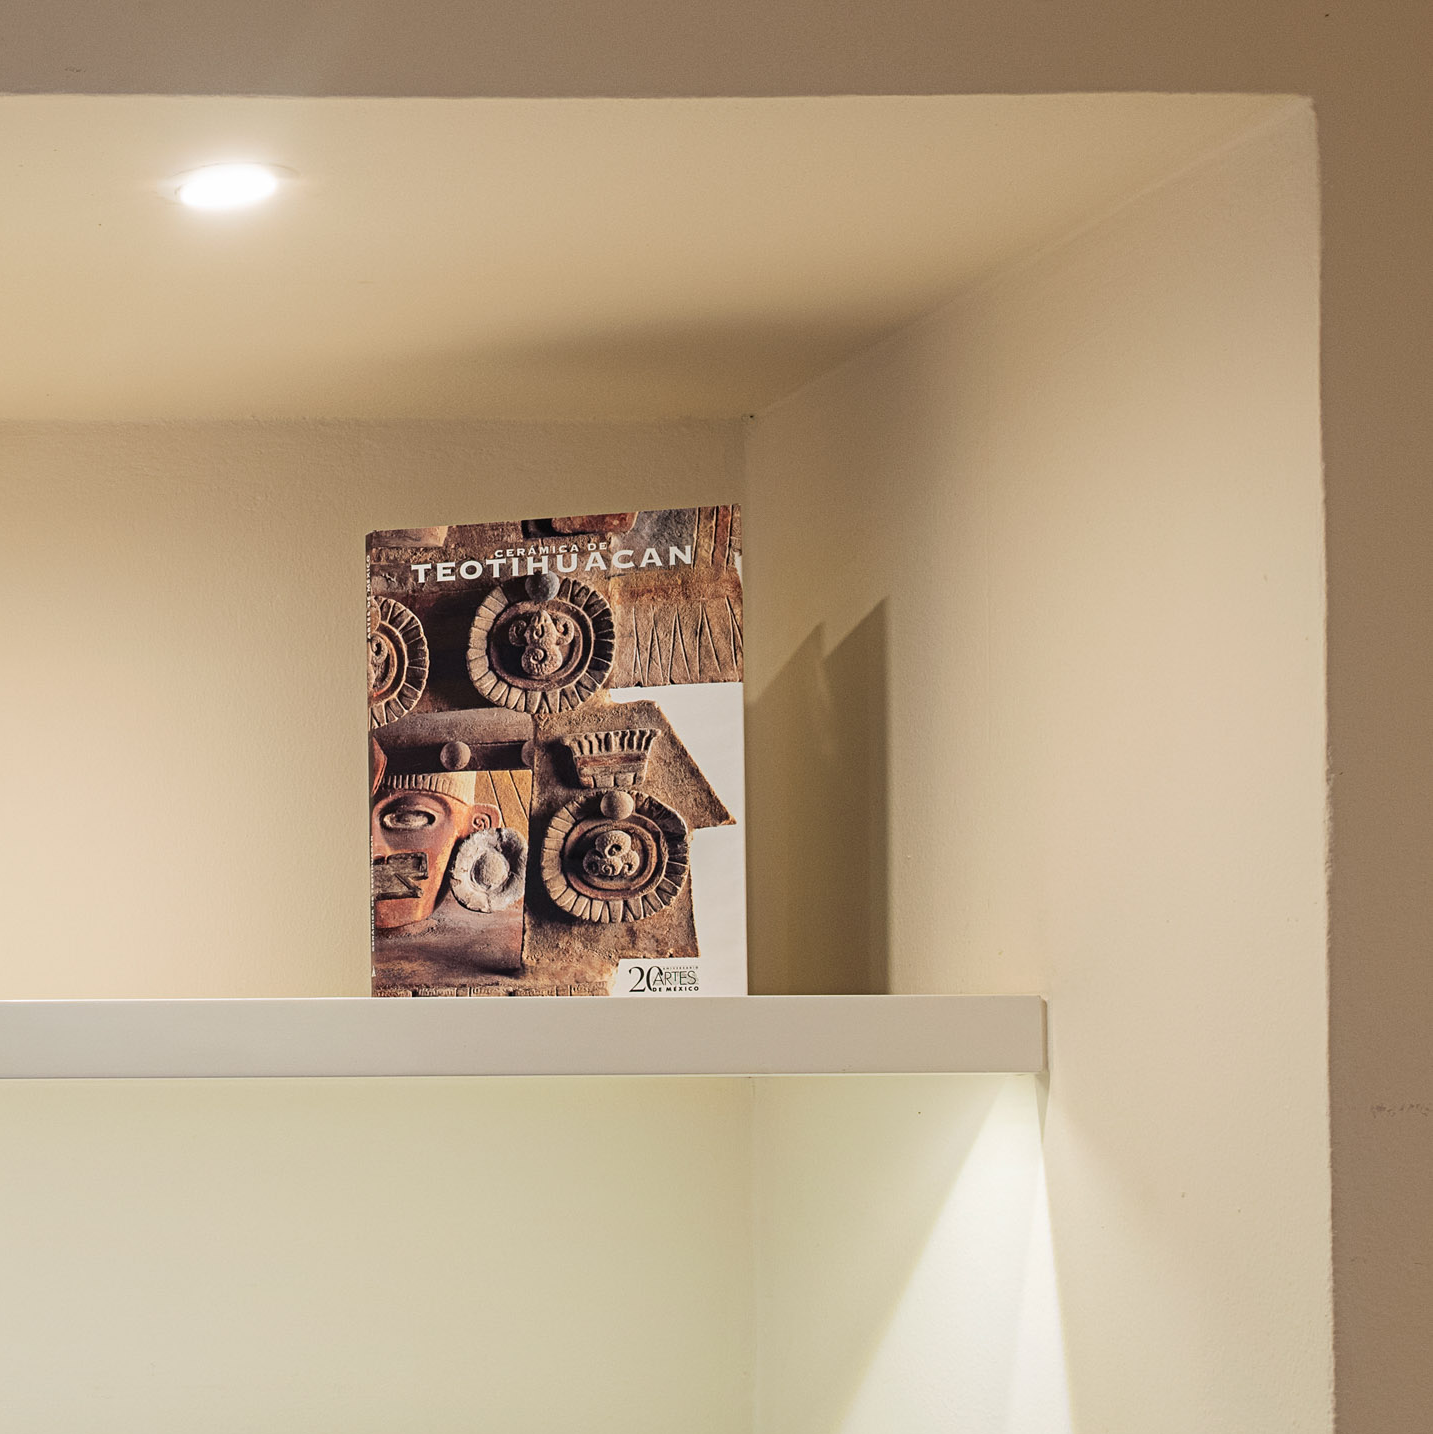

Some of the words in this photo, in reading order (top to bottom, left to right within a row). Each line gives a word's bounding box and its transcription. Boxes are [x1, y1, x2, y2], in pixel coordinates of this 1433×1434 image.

[495, 544, 579, 558] CERÁMICA
[587, 541, 607, 551] DE
[411, 545, 692, 583] TEOTIHUACAN
[628, 965, 663, 992] 20
[653, 970, 697, 985] ARTES
